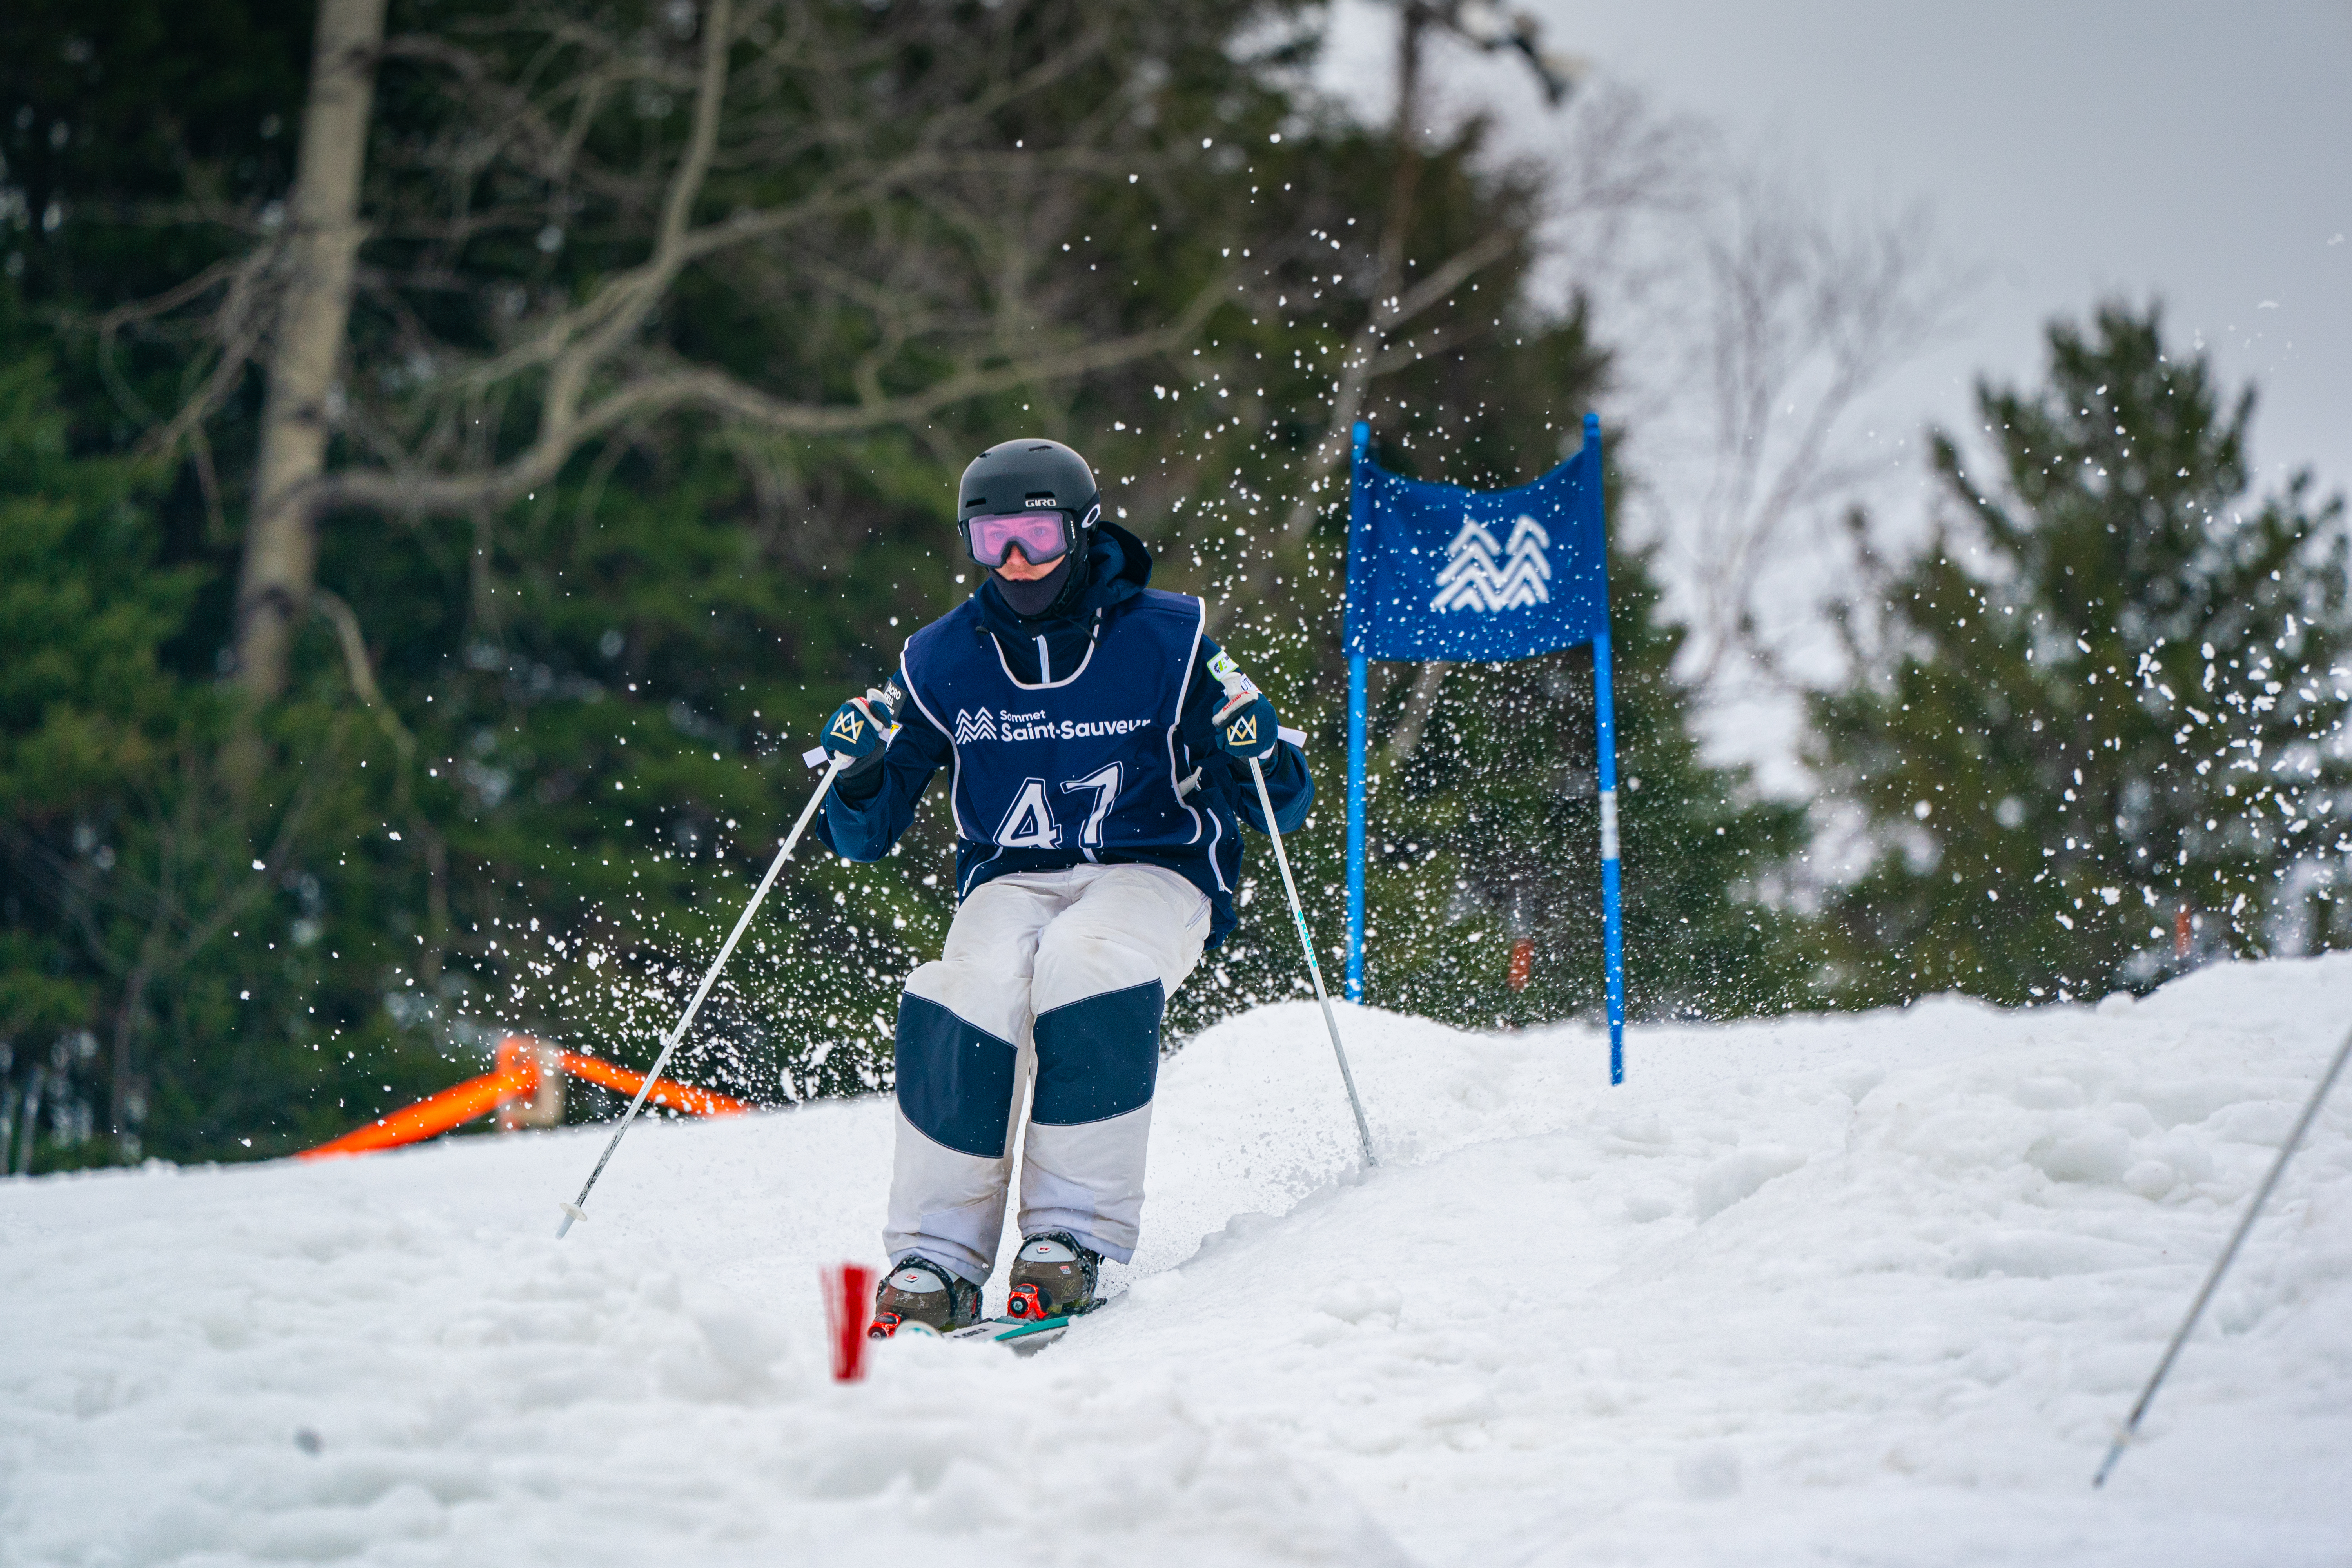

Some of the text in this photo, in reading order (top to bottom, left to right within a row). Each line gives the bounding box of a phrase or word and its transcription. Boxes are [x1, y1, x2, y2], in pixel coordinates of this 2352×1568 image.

[887, 684, 901, 700] ACRO
[1000, 710, 1046, 722] Sommet
[993, 761, 1123, 849] 47
